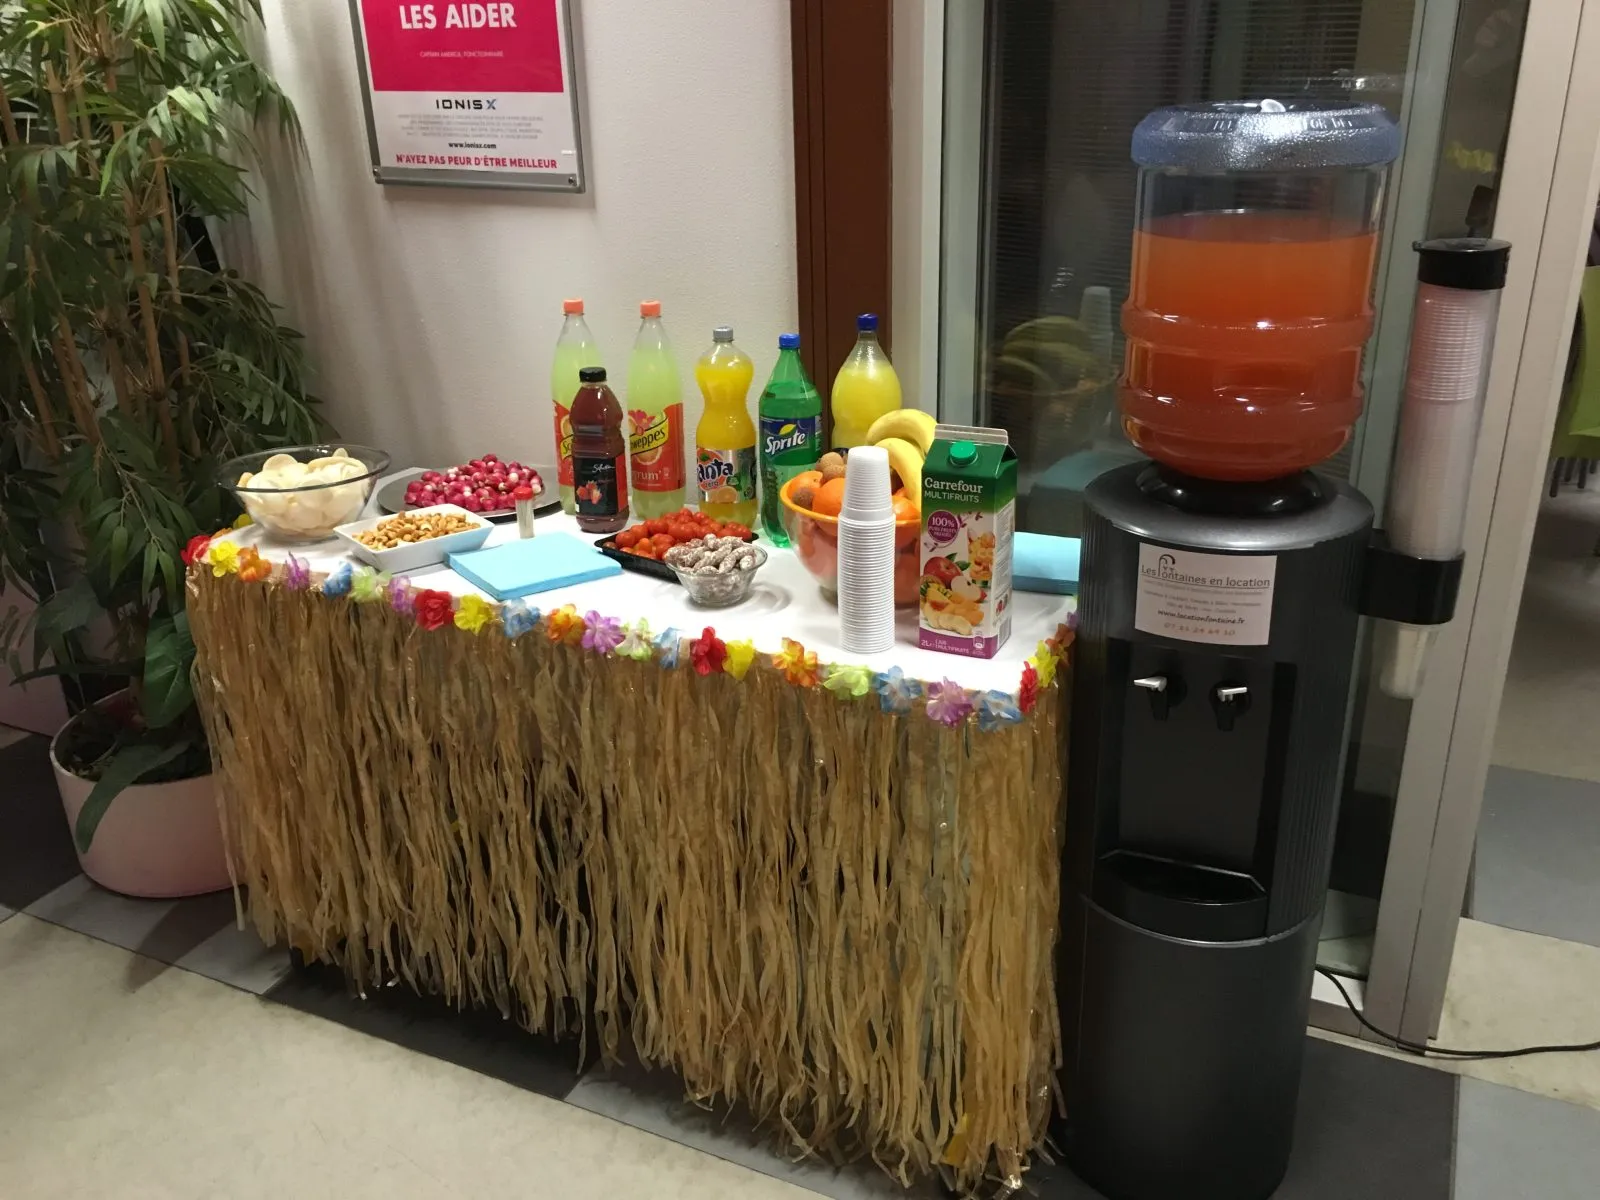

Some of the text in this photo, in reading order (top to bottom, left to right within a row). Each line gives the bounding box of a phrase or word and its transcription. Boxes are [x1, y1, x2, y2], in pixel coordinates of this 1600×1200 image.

[399, 2, 517, 29] LES AIDER
[448, 141, 497, 150] www.ionisx.com
[396, 153, 558, 169] N'AYEZ PAS PEUR D'ÊTRE MEILLEUR
[765, 430, 806, 456] Sprite
[696, 459, 734, 483] anta
[924, 477, 984, 494] Carrefour
[924, 490, 980, 503] MULTIFRUITS
[931, 517, 956, 528] 100%
[1141, 564, 1156, 575] Les
[1209, 577, 1223, 587] en
[1226, 576, 1271, 588] location
